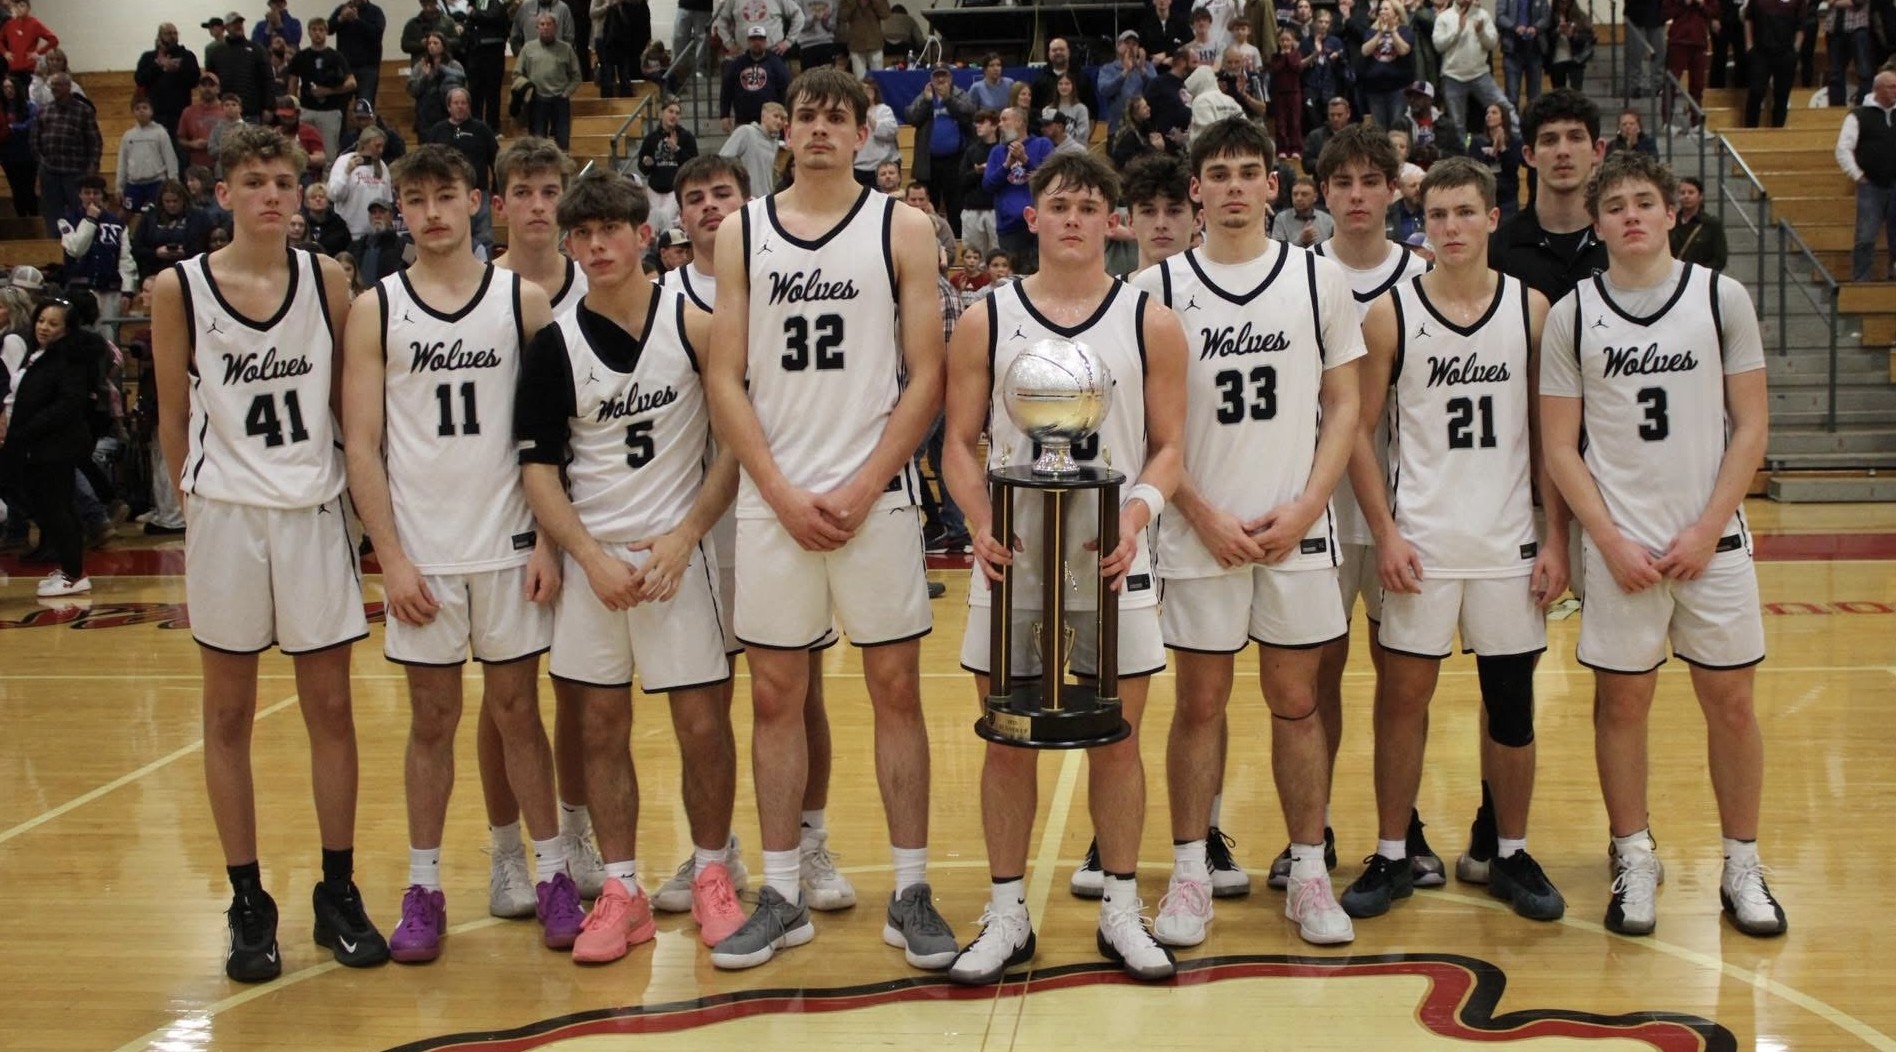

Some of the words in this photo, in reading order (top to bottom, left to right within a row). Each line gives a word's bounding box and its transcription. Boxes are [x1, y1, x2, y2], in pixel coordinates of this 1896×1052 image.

[99, 222, 123, 245] N
[768, 268, 860, 306] Wolves
[409, 338, 502, 374] Wolves
[780, 312, 846, 373] 32
[1199, 321, 1291, 361] Wolves
[1603, 342, 1699, 379] Wolves
[222, 346, 313, 386] Wolves
[1426, 352, 1511, 388] Wolves
[434, 380, 481, 437] 11
[597, 382, 678, 423] Wolves
[1214, 364, 1279, 426] 33
[1634, 385, 1671, 443] 3
[244, 388, 311, 449] 41
[1445, 394, 1499, 451] 21
[624, 417, 656, 470] 5
